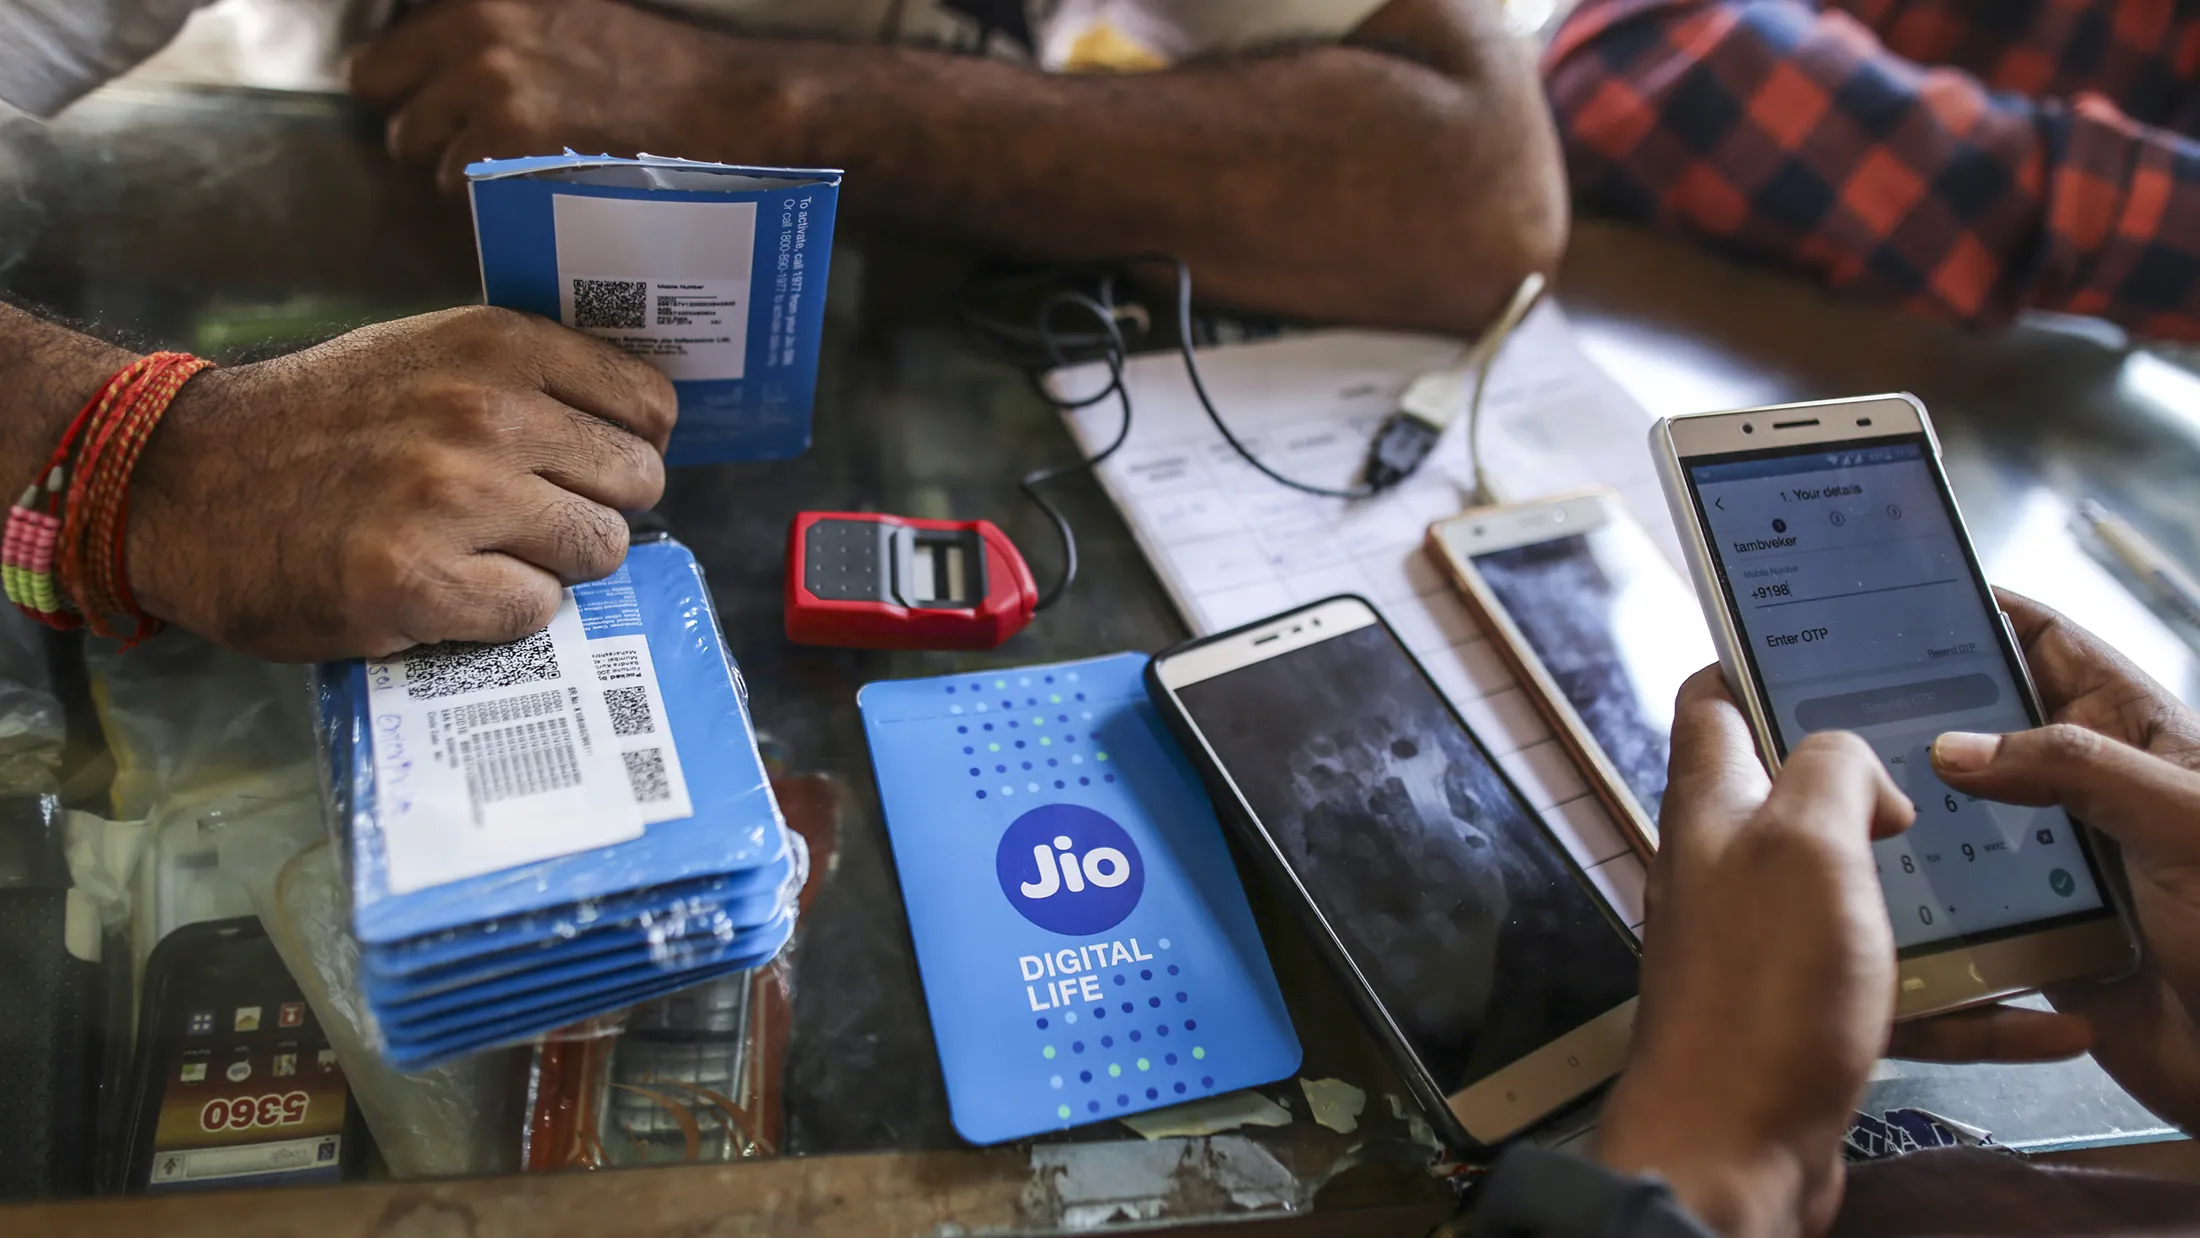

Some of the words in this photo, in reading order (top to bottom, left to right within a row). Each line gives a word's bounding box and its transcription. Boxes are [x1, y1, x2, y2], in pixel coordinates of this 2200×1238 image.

[784, 199, 795, 210] Or
[801, 197, 811, 209] To
[782, 212, 792, 227] call
[794, 211, 808, 251] activate,
[793, 253, 804, 269] call
[792, 271, 803, 292] 1977
[1793, 486, 1820, 500] Your
[1823, 483, 1863, 498] details
[1734, 535, 1798, 554] tambveker
[1744, 568, 1768, 579] Mobile
[1770, 565, 1798, 577] Number
[1752, 584, 1788, 599] +9198
[1766, 632, 1798, 648] Enter
[1801, 628, 1828, 643] OTP
[1958, 642, 1976, 654] OTP
[610, 672, 642, 680] Packed
[550, 689, 564, 712] ICCID01
[1944, 794, 1958, 812] 6
[1020, 835, 1130, 899] Jio
[1900, 854, 1915, 874] 8
[1961, 843, 1976, 862] 9
[1918, 905, 1934, 926] 0
[1019, 938, 1153, 982] DIGITAL
[1026, 974, 1103, 1012] LIFE
[200, 1090, 310, 1132] 5360
